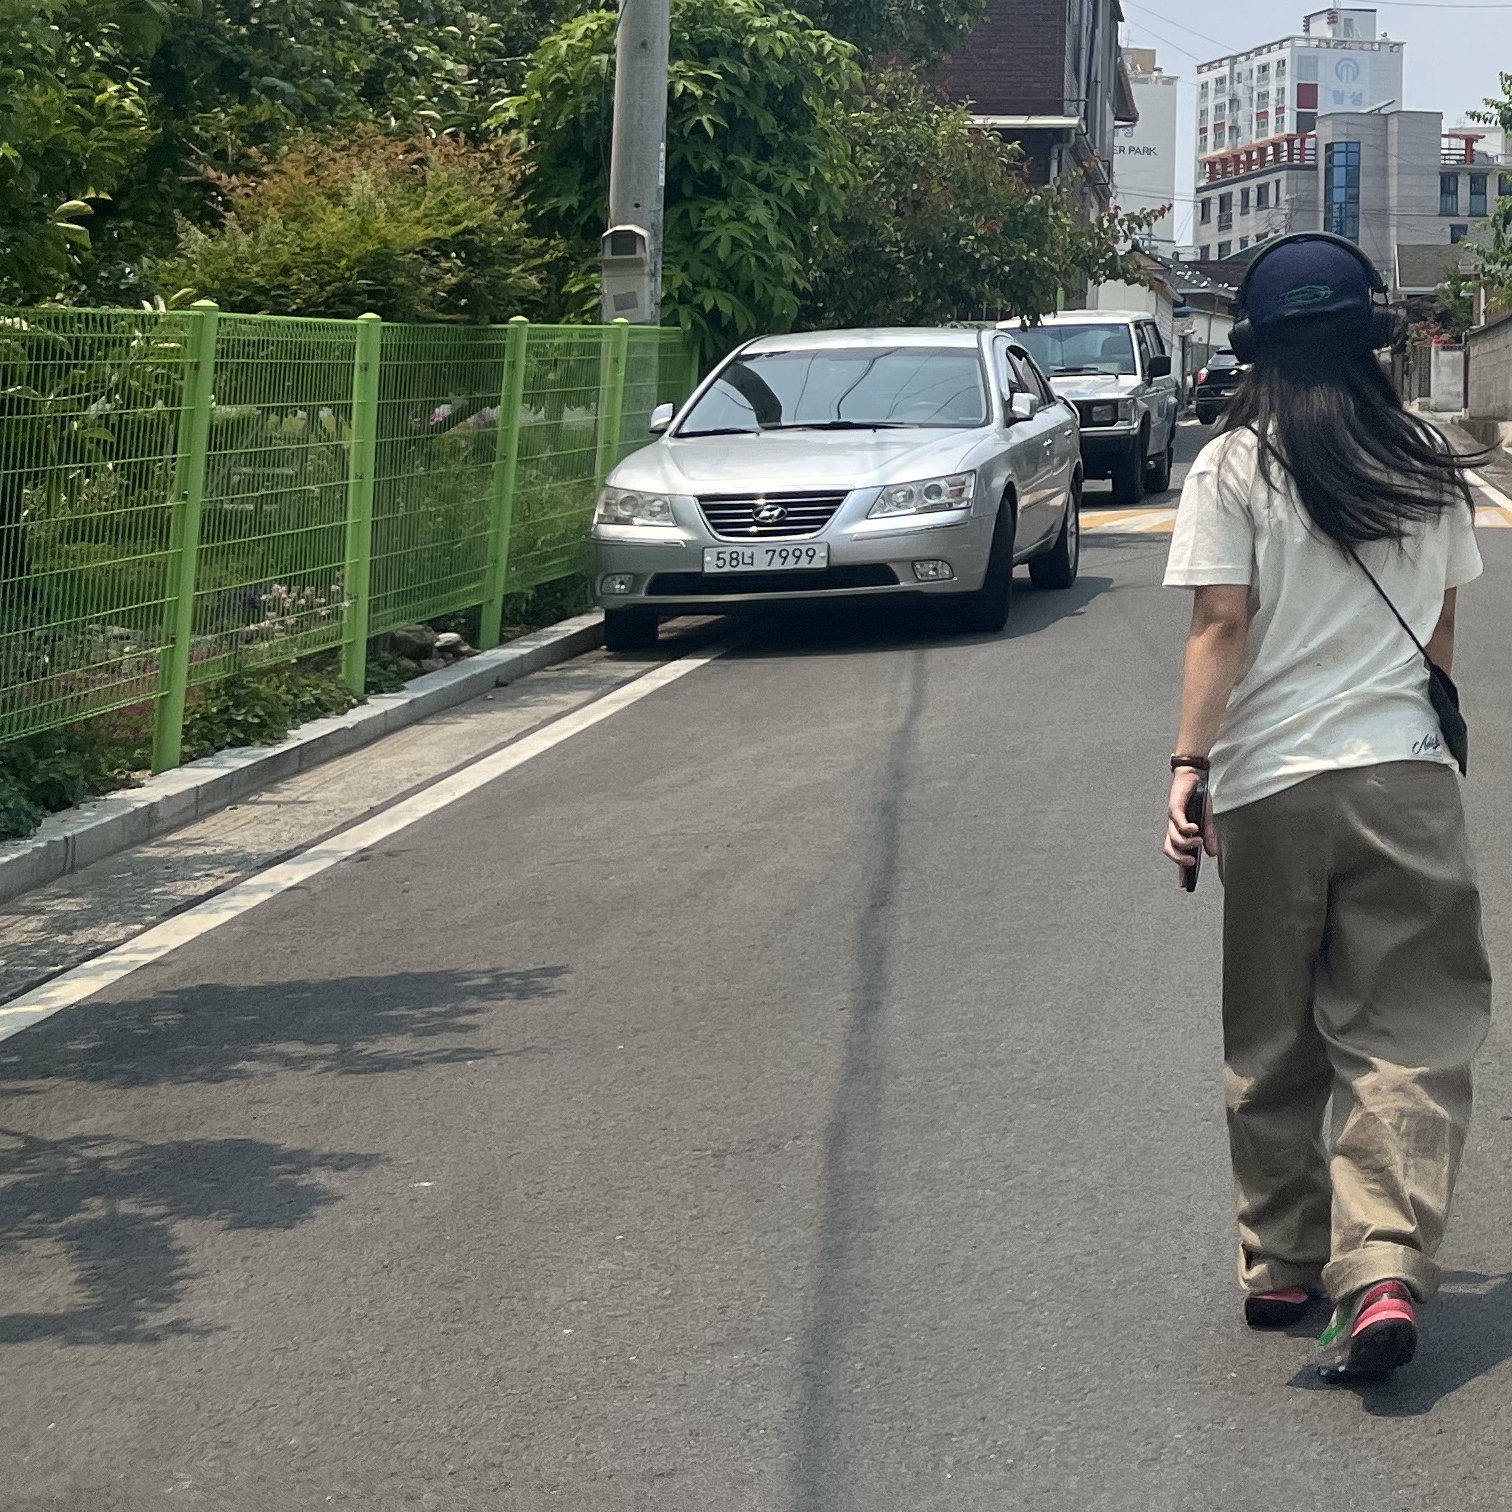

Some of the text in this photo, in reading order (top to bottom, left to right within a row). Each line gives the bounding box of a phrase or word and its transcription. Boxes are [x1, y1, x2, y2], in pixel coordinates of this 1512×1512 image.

[1128, 145, 1158, 157] PARK
[715, 547, 817, 569] 58너 7999
